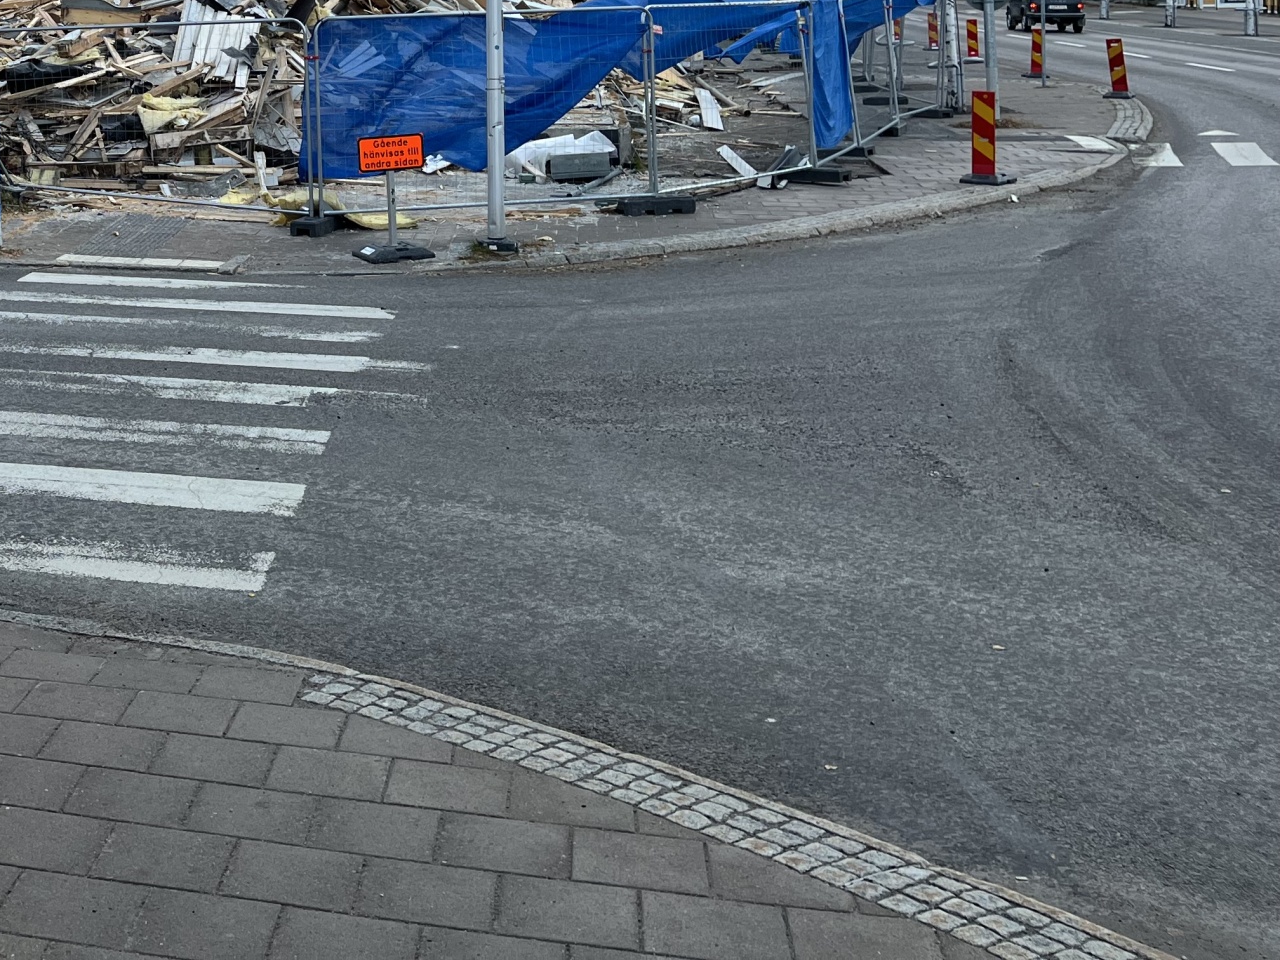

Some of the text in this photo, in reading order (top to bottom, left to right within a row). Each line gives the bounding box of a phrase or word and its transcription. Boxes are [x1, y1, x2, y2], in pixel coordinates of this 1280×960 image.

[373, 139, 408, 149] Gående
[363, 147, 419, 159] hänvisas till
[365, 157, 419, 169] andra sidan
